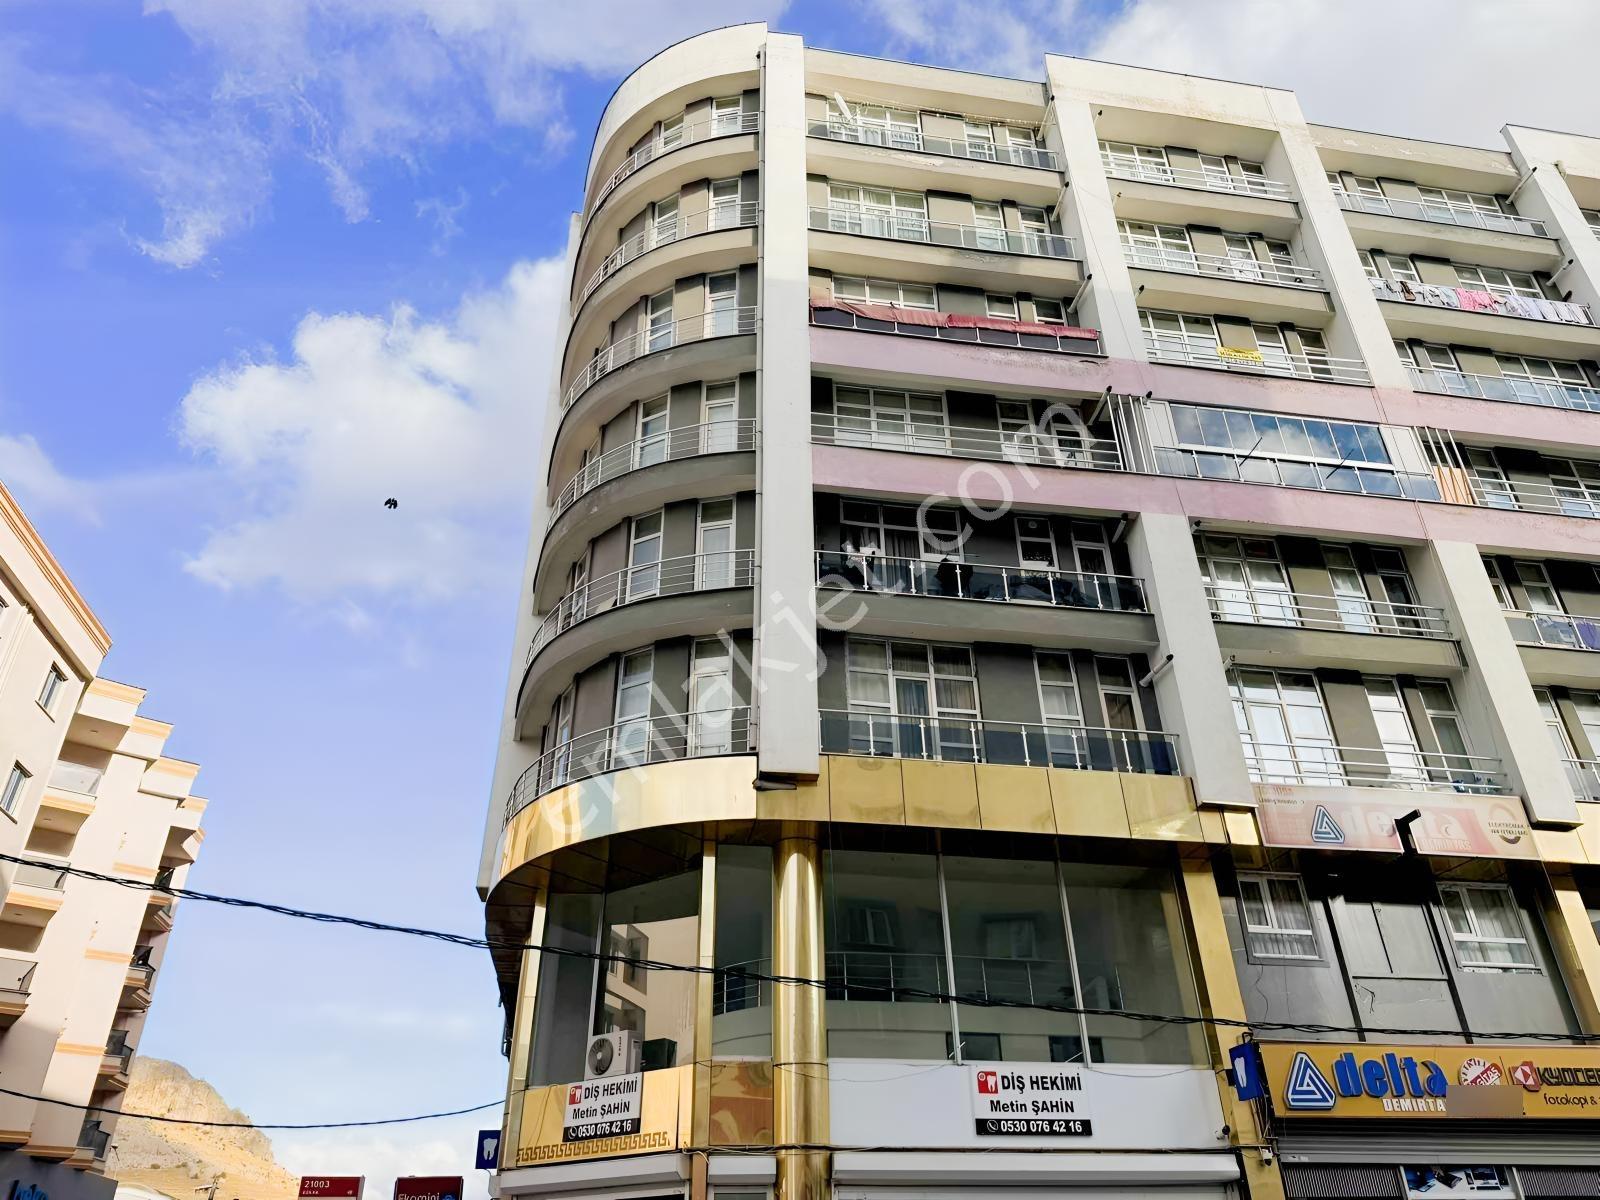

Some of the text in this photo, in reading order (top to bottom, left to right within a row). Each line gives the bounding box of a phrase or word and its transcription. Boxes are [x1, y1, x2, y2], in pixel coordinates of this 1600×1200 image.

[1001, 1072, 1082, 1094] DİŞ HEKİMİ
[1332, 1052, 1448, 1098] delta
[584, 1076, 638, 1101] DİŞ HEKİMİ
[572, 1099, 630, 1120] Metin ŞAHİN
[989, 1098, 1075, 1115] Metin ŞAHİN
[1544, 1093, 1588, 1109] fotokopi
[577, 1120, 632, 1138] 0530 076 42 16
[1000, 1120, 1083, 1133] 0530 076 42 16
[304, 1180, 330, 1188] 21003
